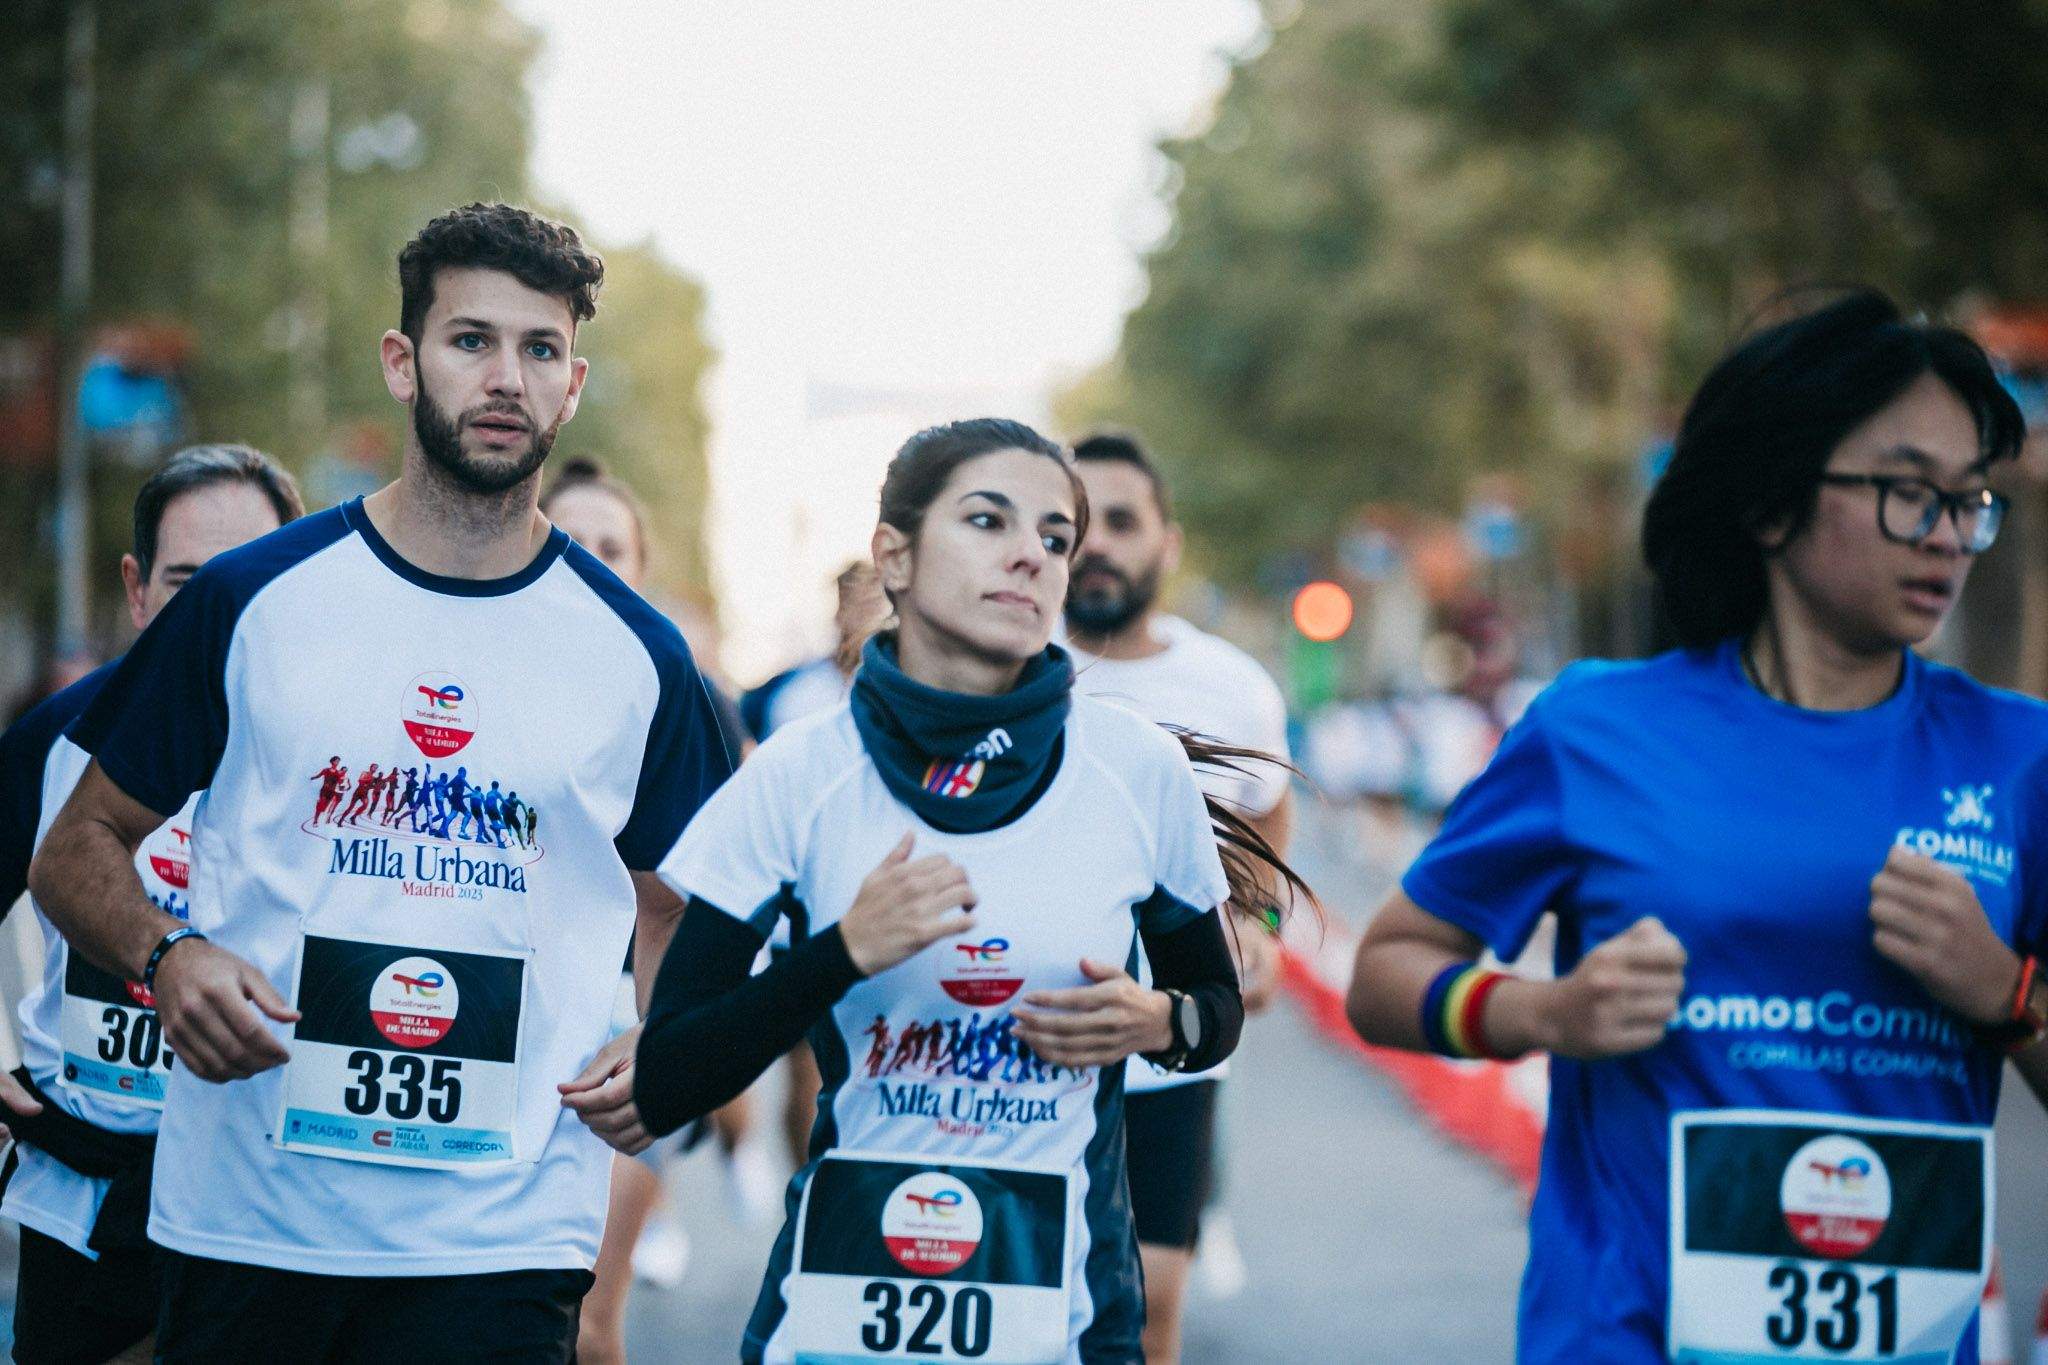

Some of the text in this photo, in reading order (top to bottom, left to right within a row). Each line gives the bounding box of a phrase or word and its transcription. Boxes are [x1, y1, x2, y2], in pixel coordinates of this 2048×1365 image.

[328, 837, 527, 893] Milla Urbana
[401, 881, 483, 901] Madrid 2023
[98, 1007, 175, 1071] 30
[399, 1015, 430, 1027] MILLA
[403, 1026, 440, 1038] MADRID
[344, 1050, 463, 1125] 335
[951, 1086, 1058, 1124] Urbana
[306, 1122, 359, 1141] MADRID
[861, 1281, 992, 1358] 320
[1766, 1266, 1898, 1357] 331
